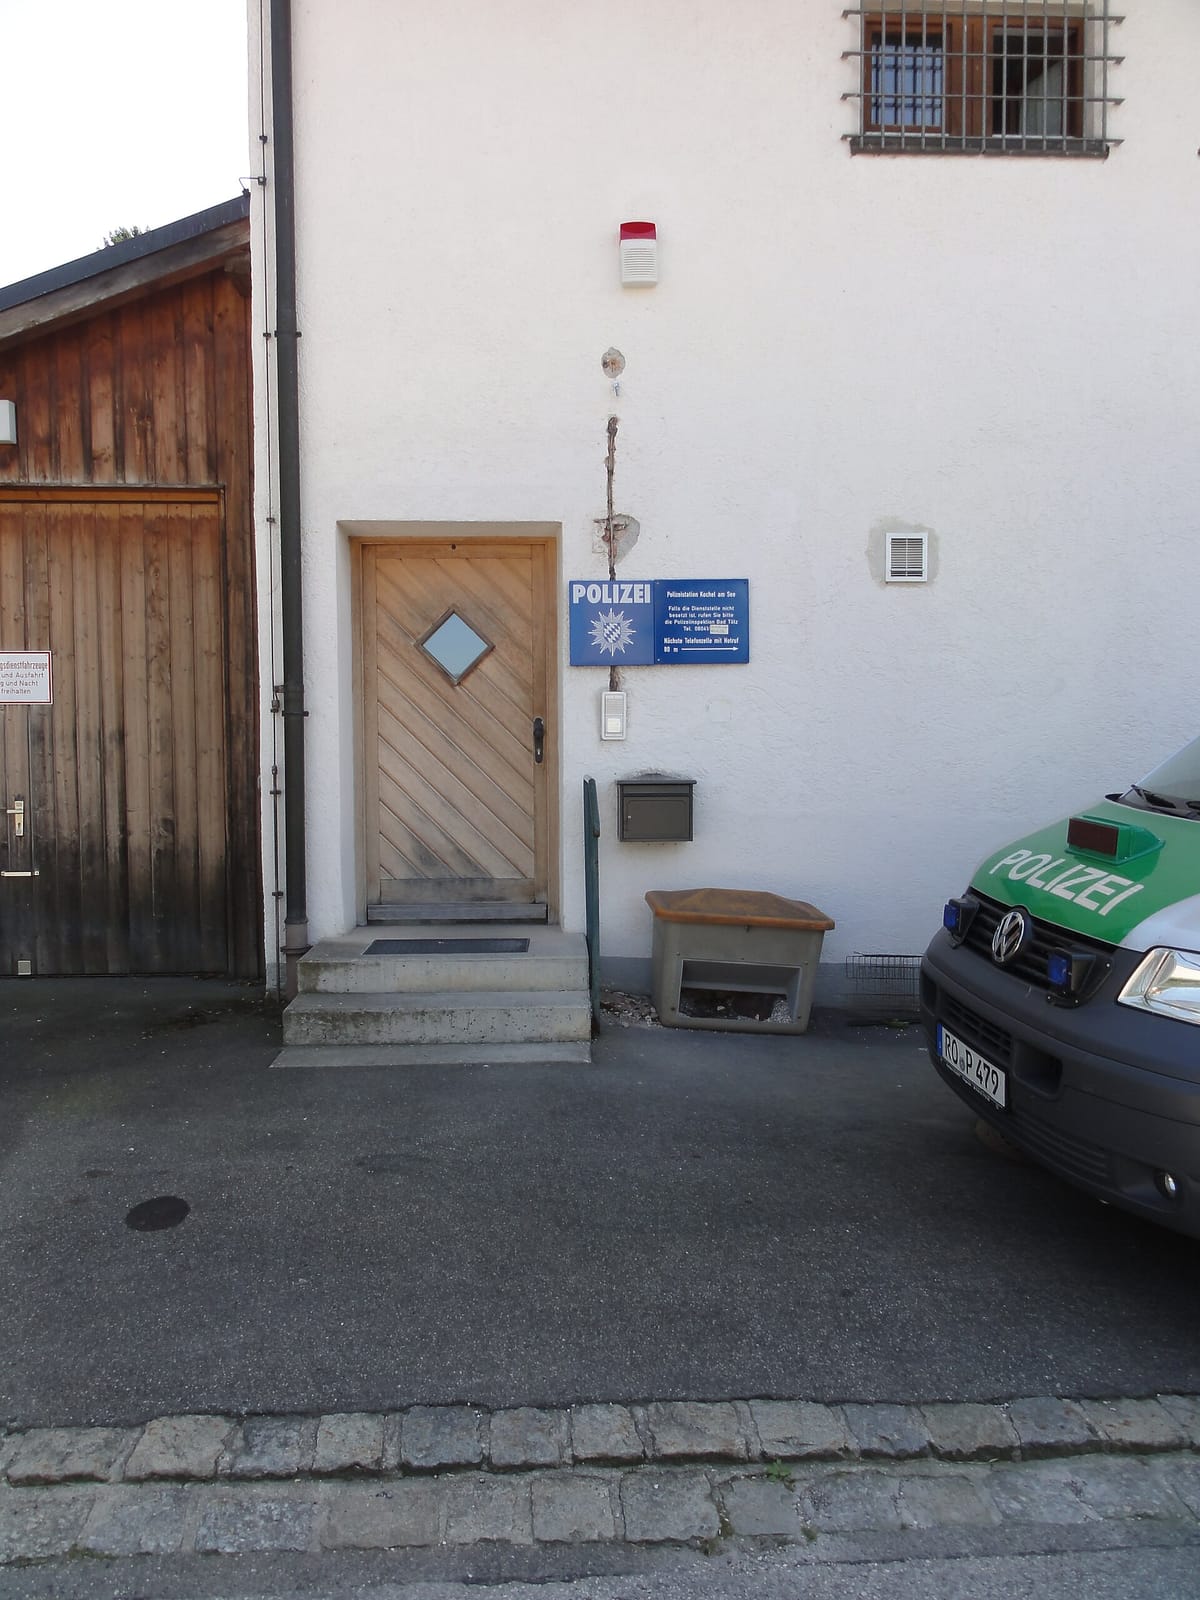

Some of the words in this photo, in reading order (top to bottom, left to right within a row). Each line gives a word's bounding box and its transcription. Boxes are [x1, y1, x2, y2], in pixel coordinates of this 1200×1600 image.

[572, 584, 651, 604] POLIZEI
[989, 849, 1144, 916] POLIZEI
[945, 1033, 958, 1064] RO
[966, 1050, 973, 1074] P
[976, 1059, 999, 1095] 479
